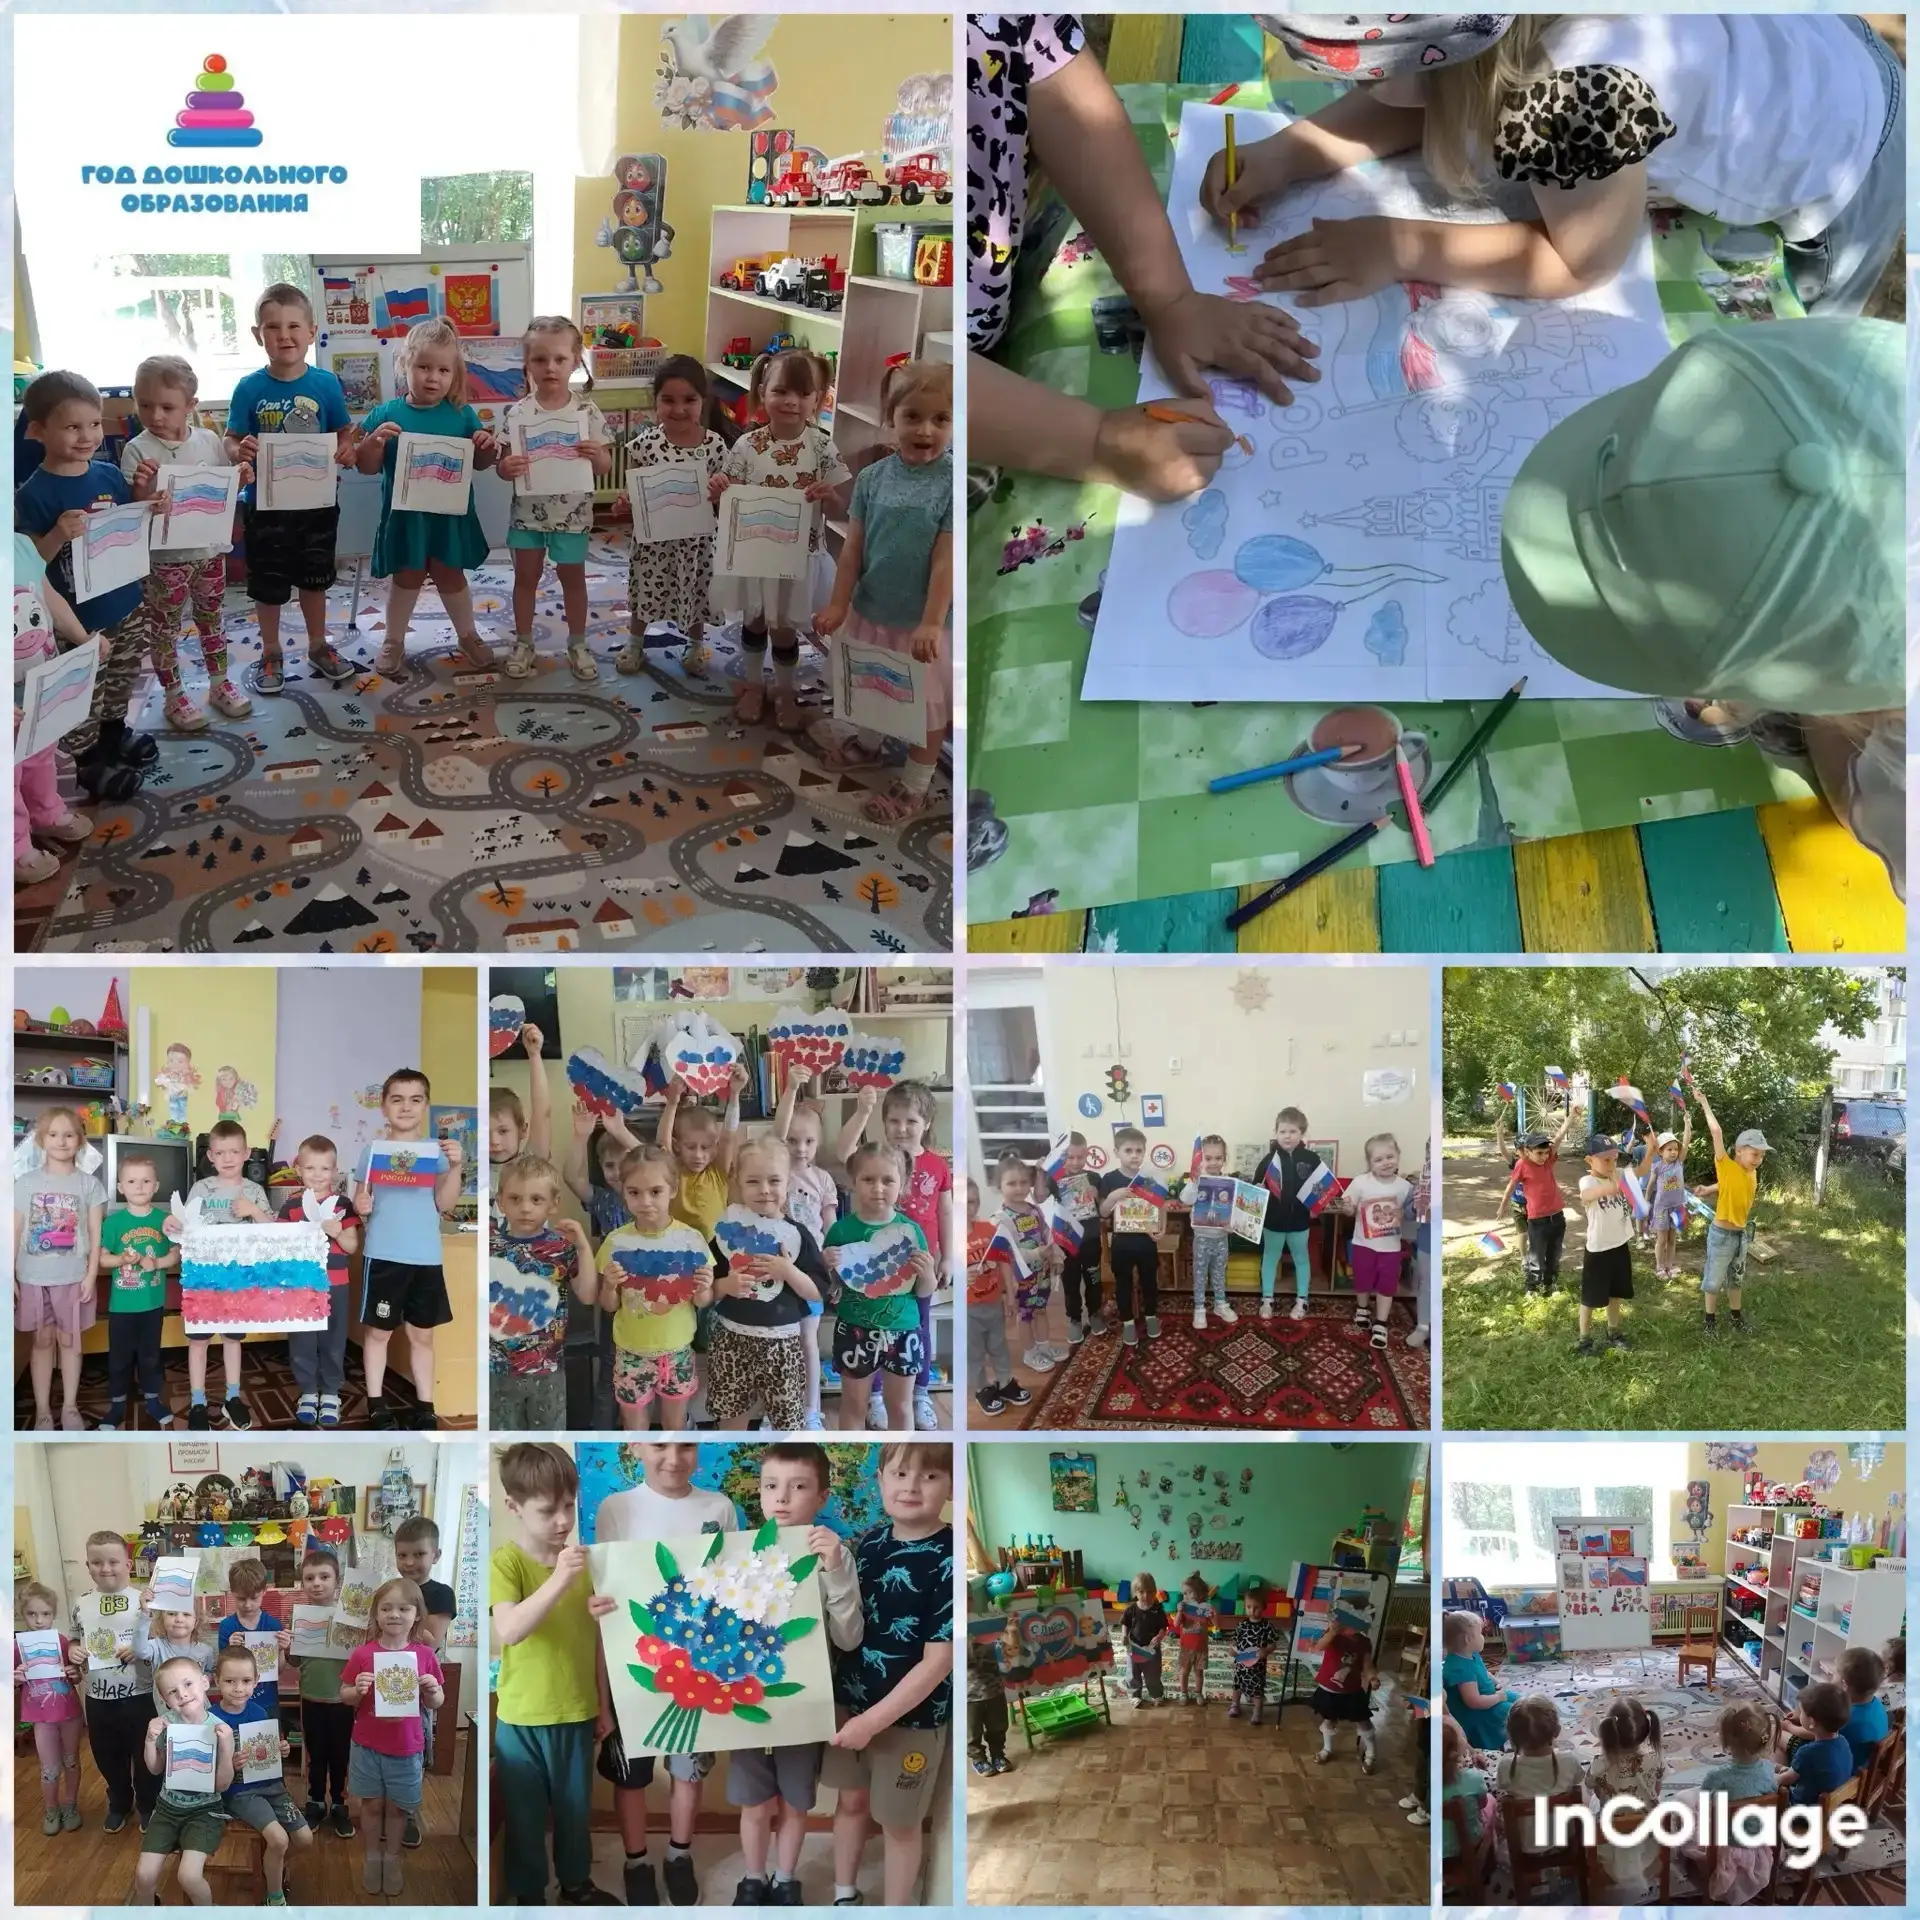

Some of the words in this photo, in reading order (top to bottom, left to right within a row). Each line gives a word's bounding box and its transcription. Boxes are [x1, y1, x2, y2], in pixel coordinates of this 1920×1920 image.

[256, 399, 292, 414] Can't
[258, 411, 284, 425] STOP
[180, 1534, 186, 1543] 2
[209, 1536, 215, 1545] 3
[237, 1534, 243, 1543] 4
[100, 1595, 128, 1616] 83
